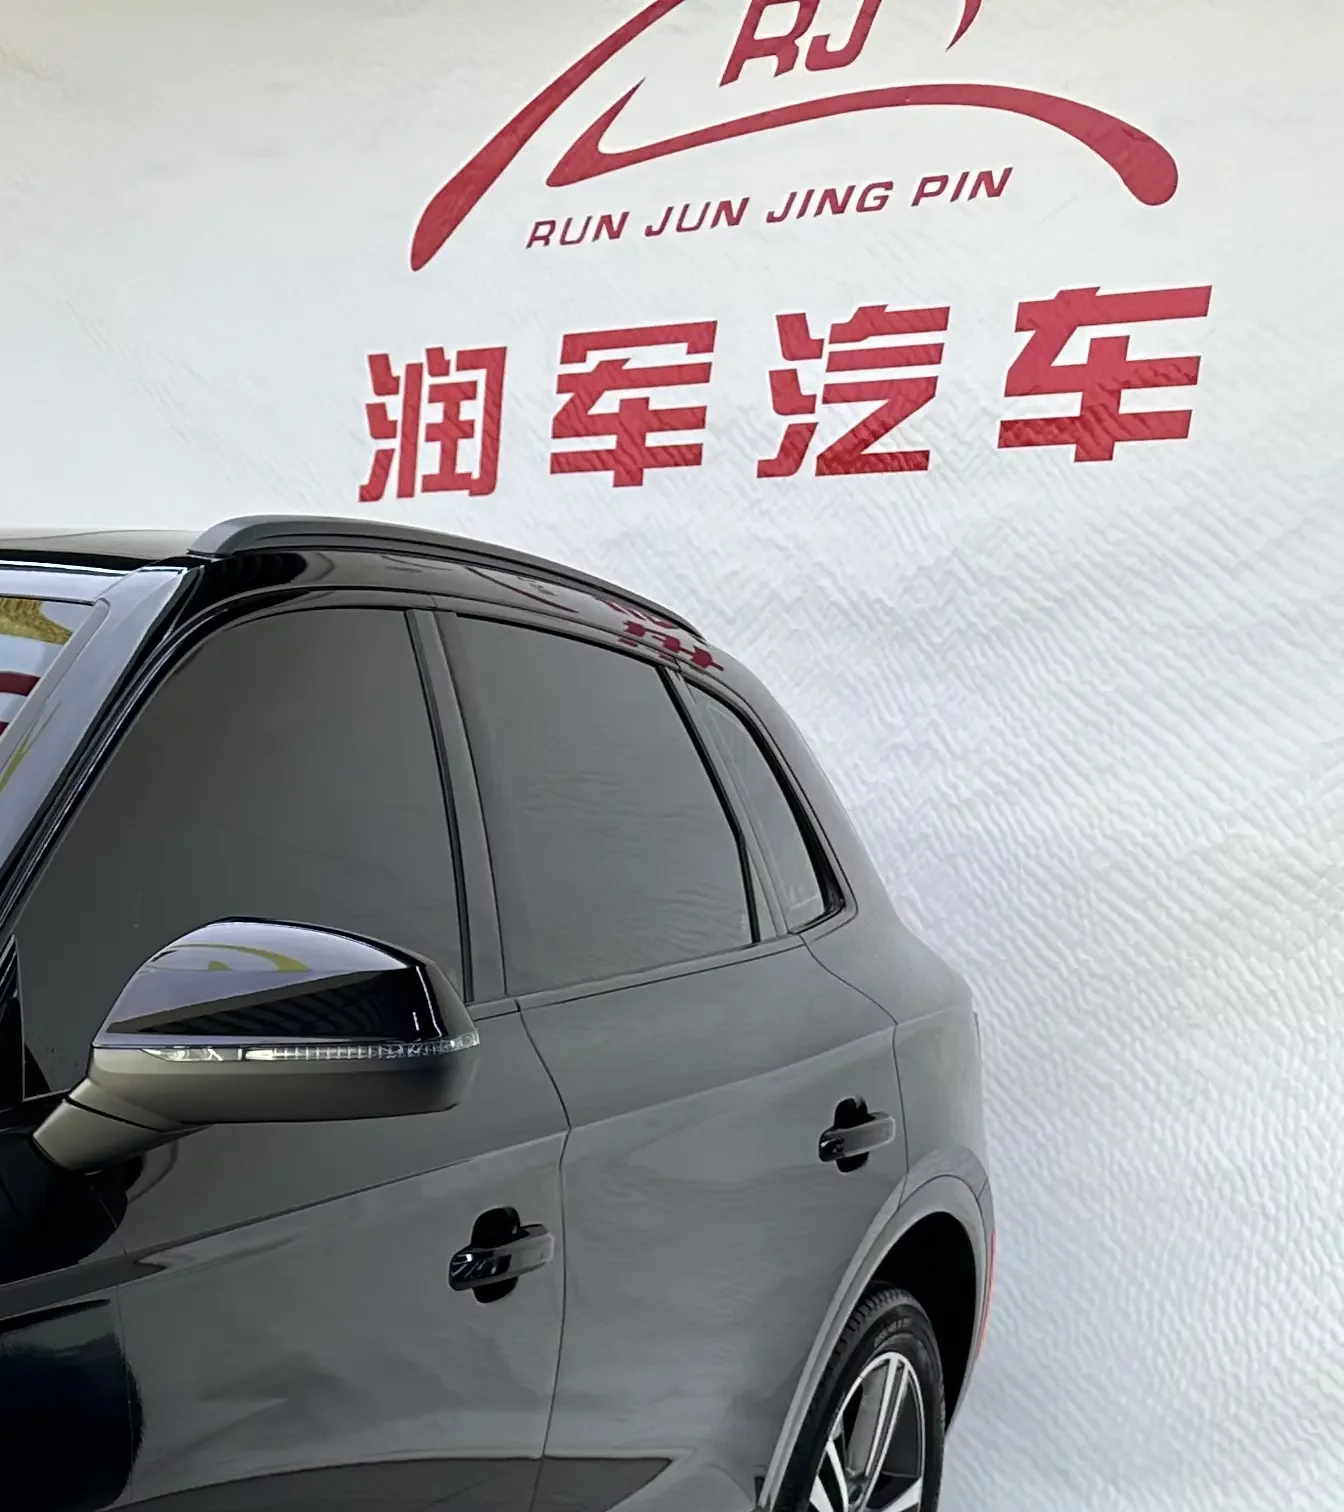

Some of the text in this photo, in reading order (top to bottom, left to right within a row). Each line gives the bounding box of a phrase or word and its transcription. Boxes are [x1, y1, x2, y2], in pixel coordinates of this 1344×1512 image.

[719, 0, 881, 86] RJ
[526, 167, 1013, 249] RUN JUN JING PIN
[358, 285, 1212, 503] 润军汽车
